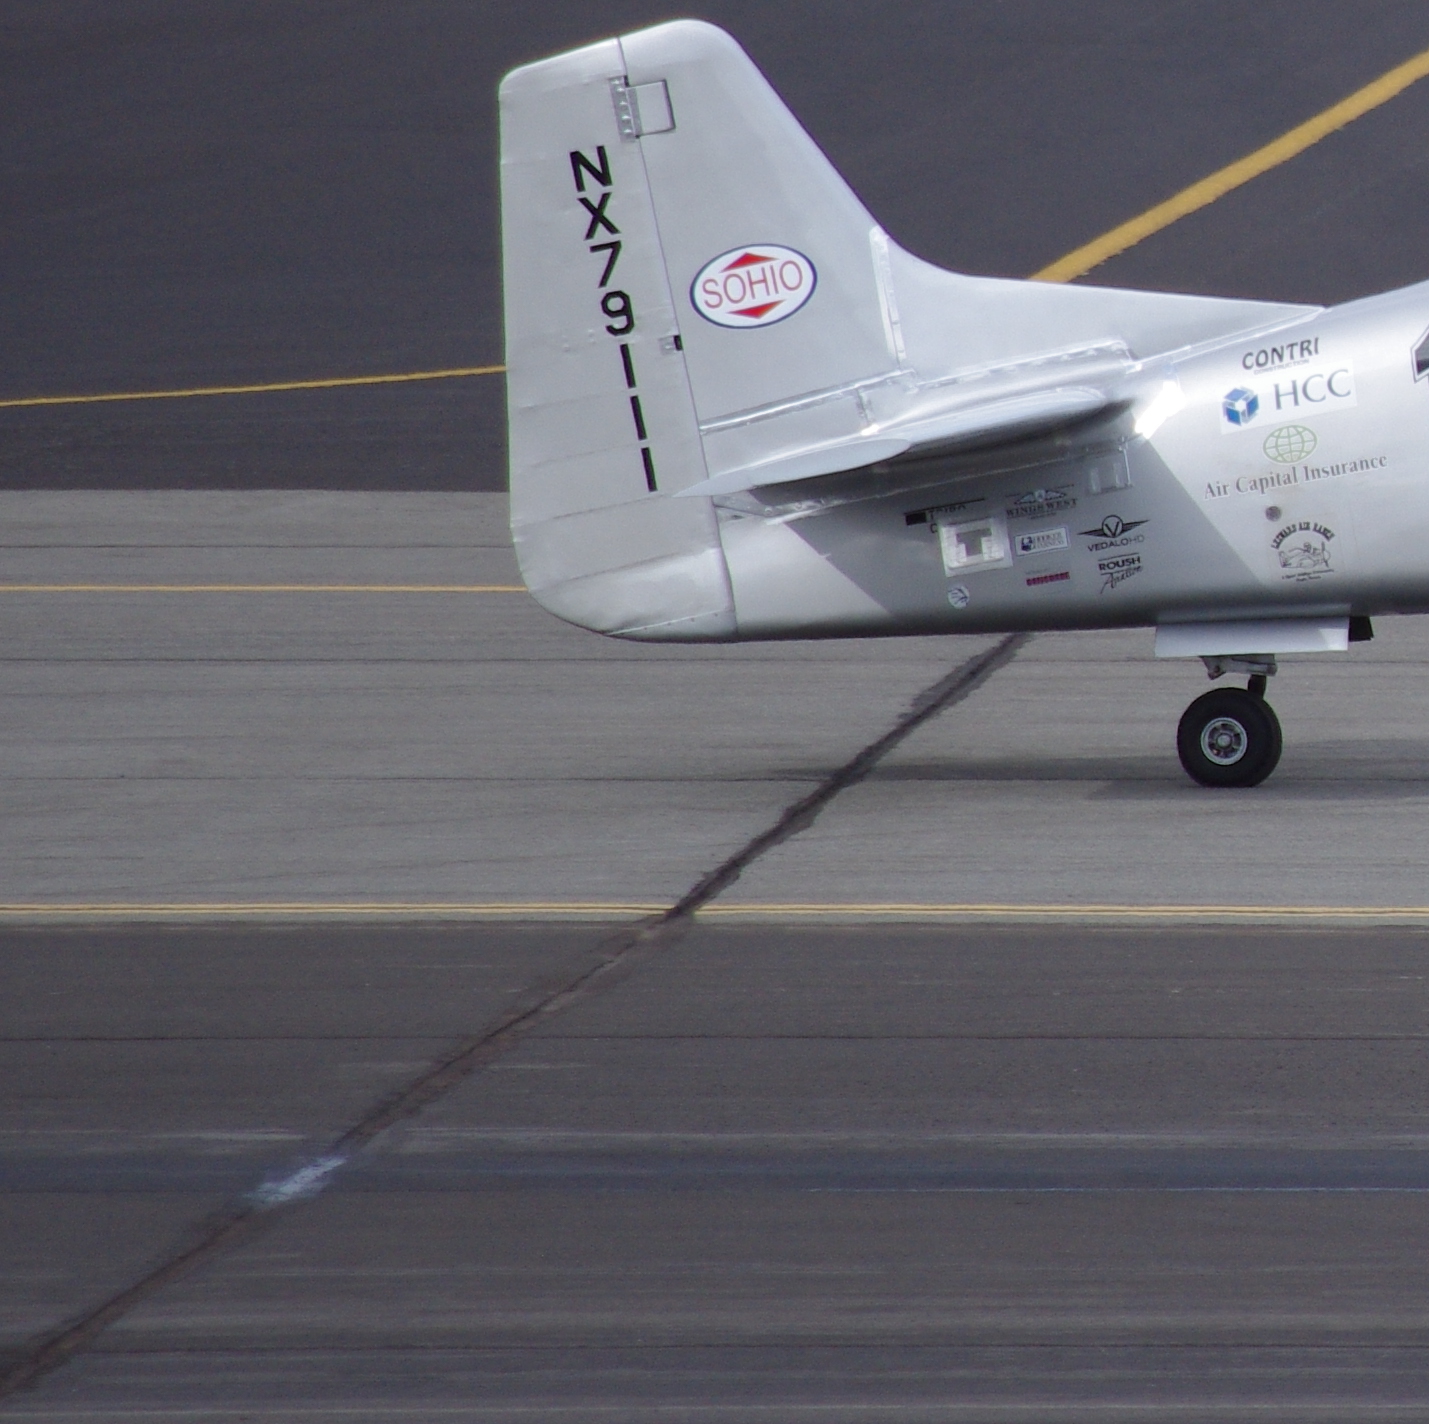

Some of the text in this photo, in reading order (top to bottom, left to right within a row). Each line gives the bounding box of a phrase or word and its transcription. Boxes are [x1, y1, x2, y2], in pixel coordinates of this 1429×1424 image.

[702, 259, 805, 309] SOHIO
[569, 145, 659, 493] NX79111
[1242, 337, 1320, 371] CONTRI
[1274, 369, 1352, 411] HCC
[1204, 453, 1389, 501] Air Capital Insurance
[1098, 556, 1142, 571] ROUSH
